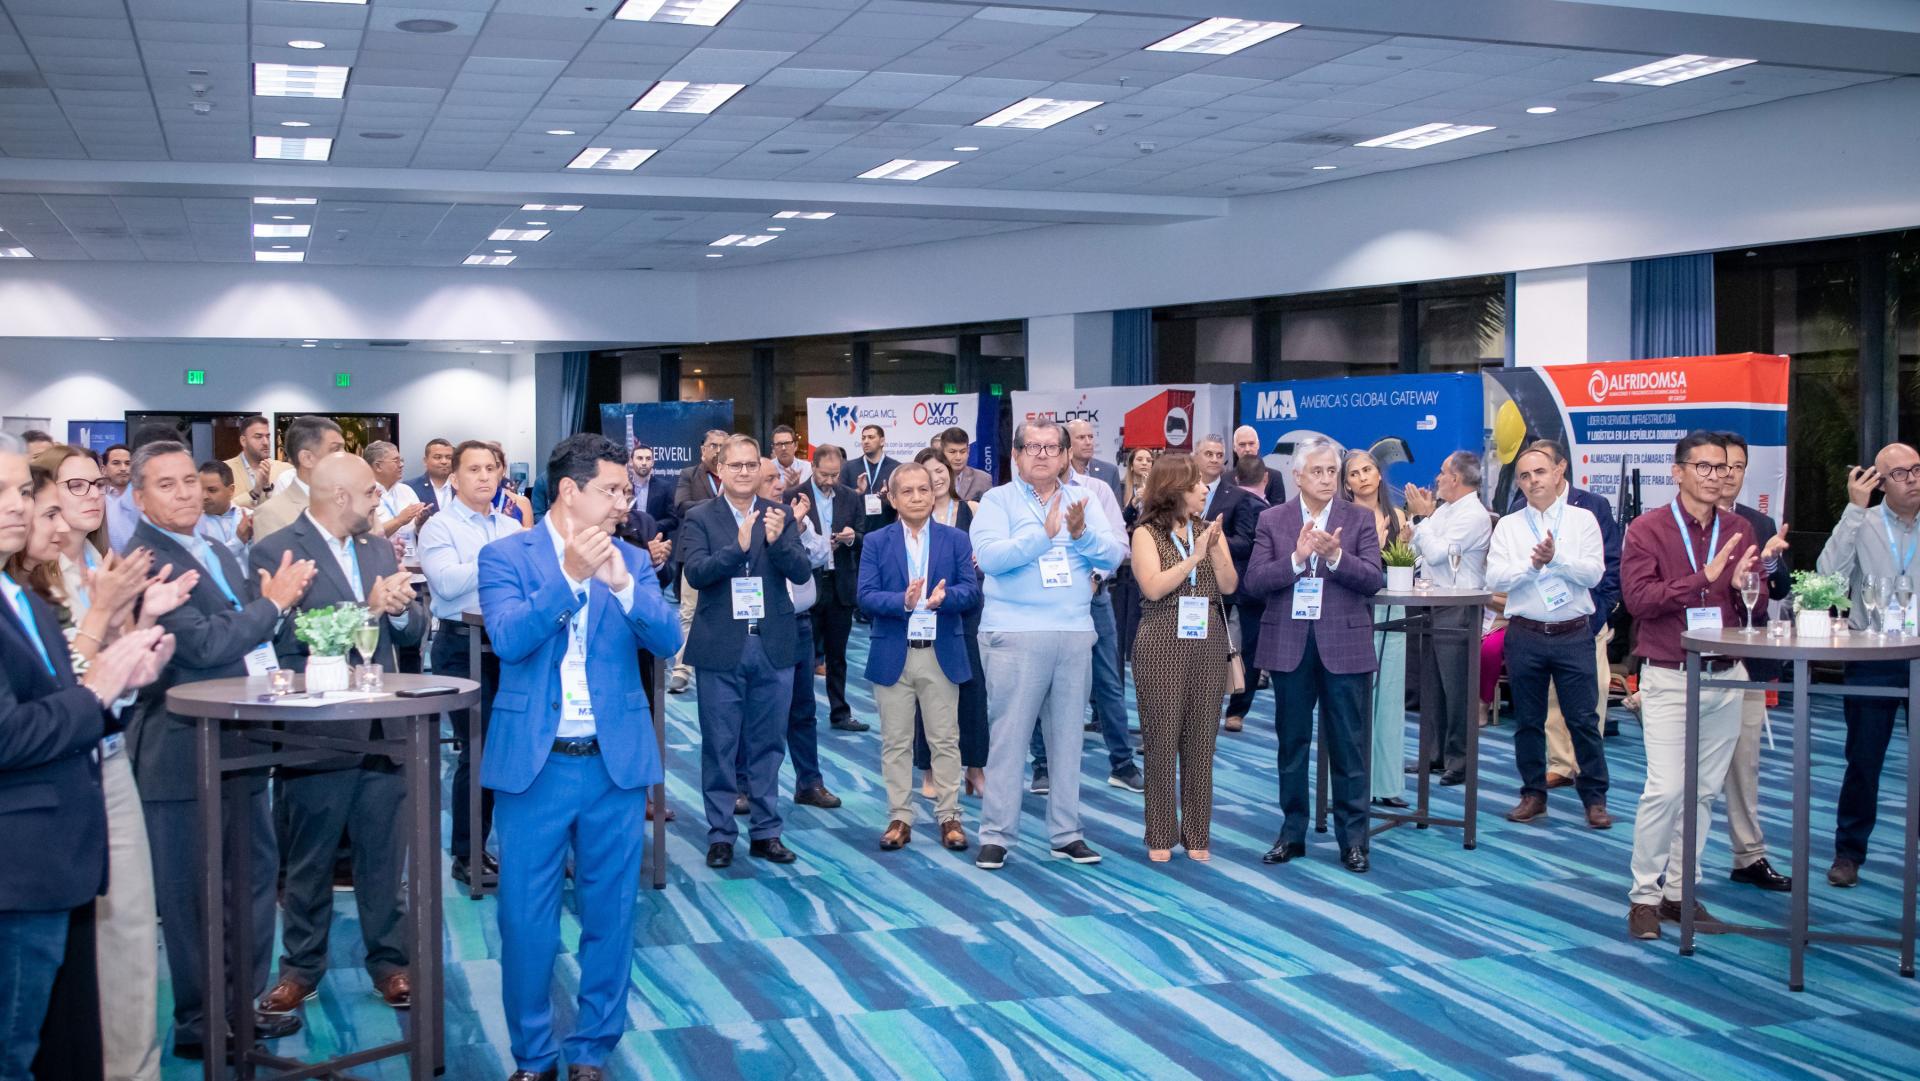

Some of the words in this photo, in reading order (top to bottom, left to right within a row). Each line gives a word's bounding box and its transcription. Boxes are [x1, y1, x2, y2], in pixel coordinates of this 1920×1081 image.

[188, 370, 204, 385] EXIT
[1609, 371, 1687, 390] ALFRIDOMSA
[1300, 393, 1349, 408] AMERICA'S
[1351, 392, 1389, 407] GLOBAL
[1390, 390, 1439, 406] GATEWAY
[927, 416, 959, 426] CARGO
[1616, 431, 1622, 440] EN
[1623, 430, 1629, 440] LA
